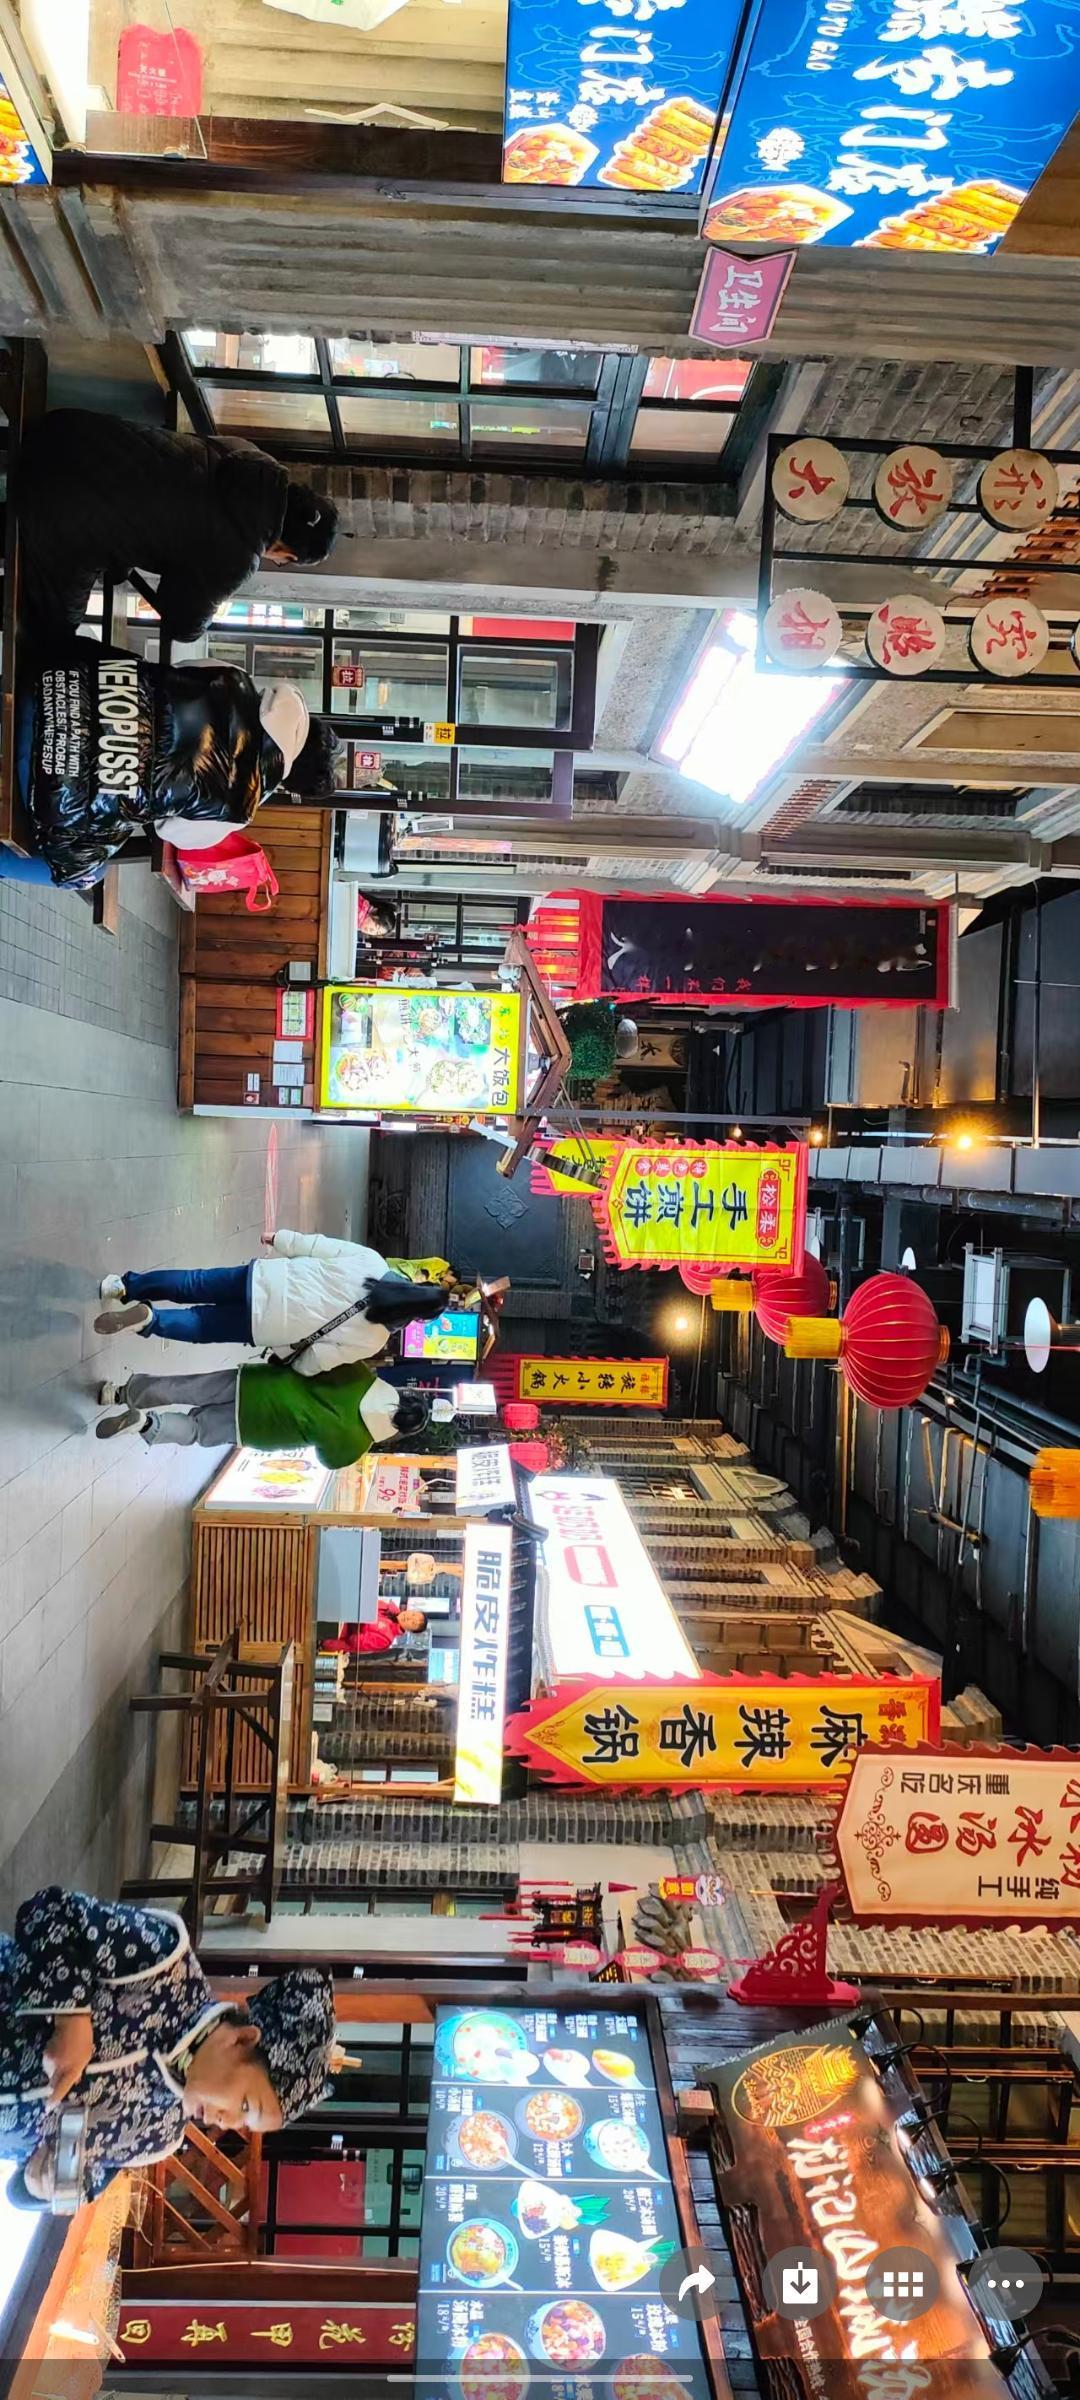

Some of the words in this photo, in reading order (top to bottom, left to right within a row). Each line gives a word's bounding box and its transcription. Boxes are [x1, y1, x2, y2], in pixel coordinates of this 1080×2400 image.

[816, 16, 849, 37] YU
[805, 41, 839, 72] GAO
[708, 265, 763, 333] 卫生间
[69, 670, 79, 678] IF
[341, 669, 354, 685] 拉
[69, 679, 79, 697] YOU
[69, 698, 79, 719] FIND
[69, 728, 80, 753] PATH
[439, 727, 452, 740] 拉
[54, 733, 67, 775] PROBAB
[68, 754, 79, 778] WITH
[637, 1159, 707, 1177] 特色美食
[623, 1180, 749, 1231] 手工煎饼
[759, 1183, 778, 1234] 松柔
[470, 1550, 502, 1721] 脆皮炸糕
[581, 1704, 869, 1768] 麻辣香锅
[900, 1772, 1010, 1795] 重庆名吃
[904, 1806, 1052, 1867] 冰汤圆
[977, 1876, 1060, 1900] 纯手工
